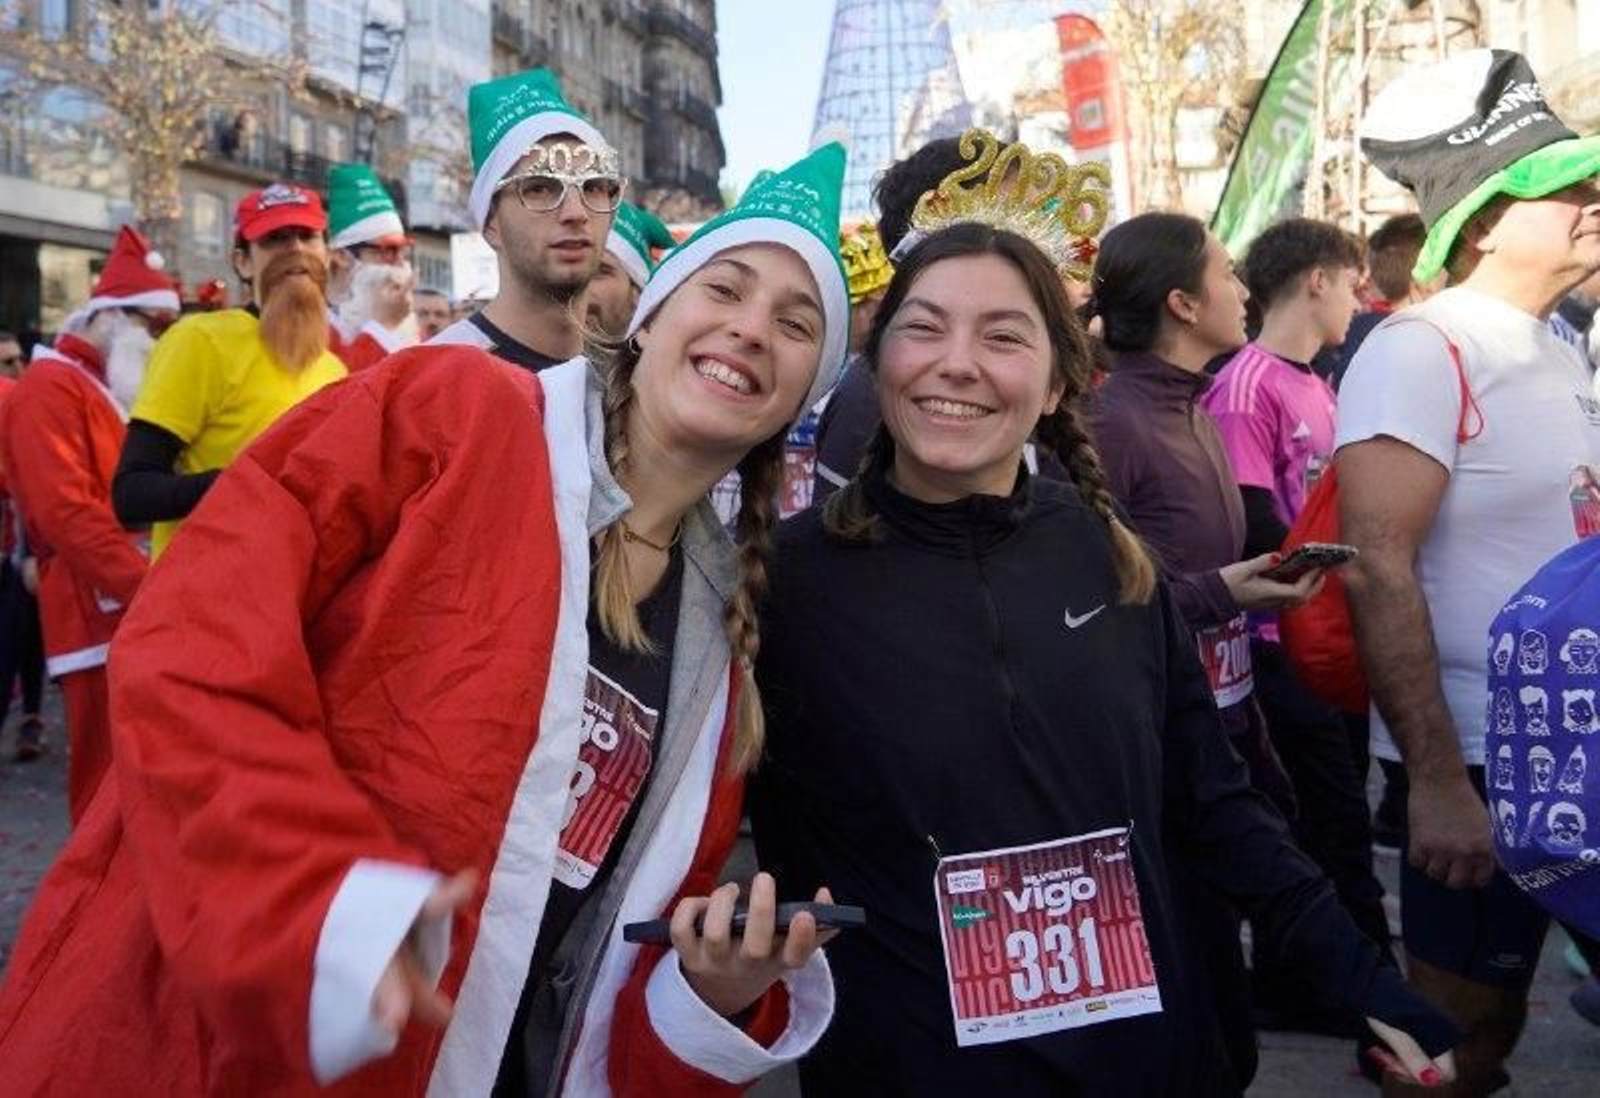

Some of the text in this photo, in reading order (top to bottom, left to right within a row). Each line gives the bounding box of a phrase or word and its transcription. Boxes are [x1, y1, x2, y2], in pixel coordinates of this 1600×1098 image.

[937, 127, 1112, 238] 2026
[1002, 876, 1097, 917] vigo
[1006, 917, 1105, 1002] 331
